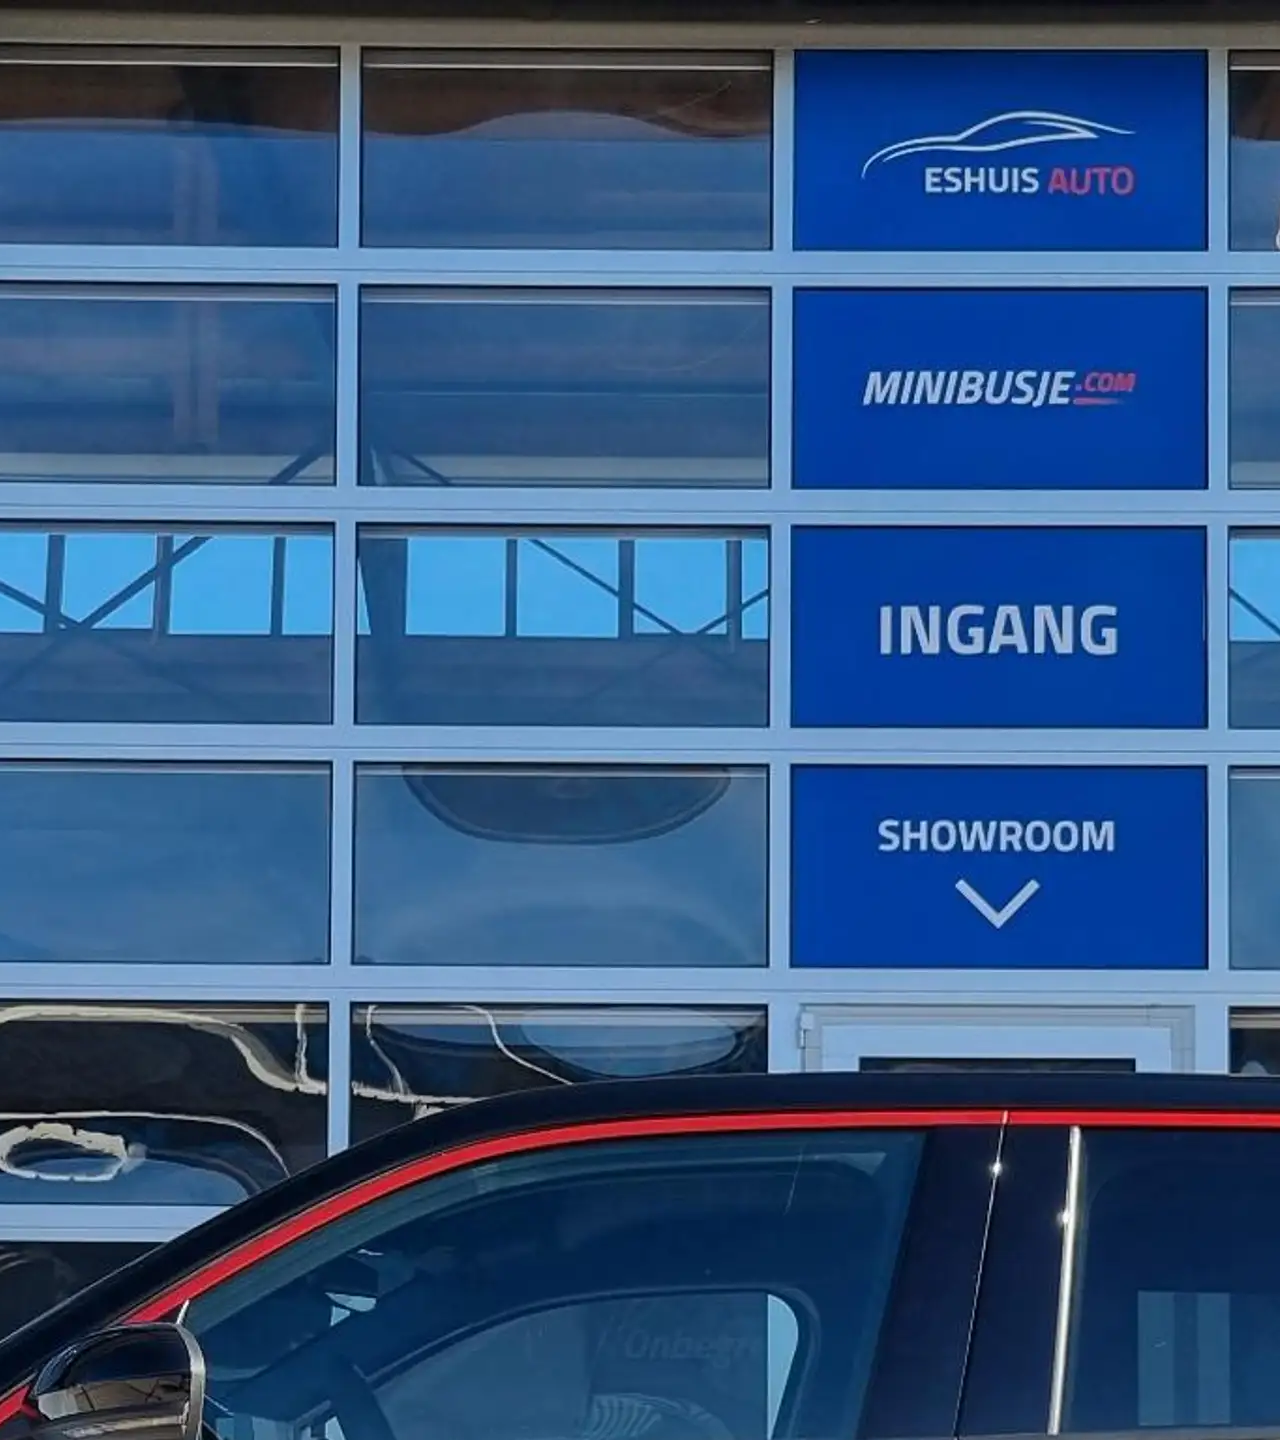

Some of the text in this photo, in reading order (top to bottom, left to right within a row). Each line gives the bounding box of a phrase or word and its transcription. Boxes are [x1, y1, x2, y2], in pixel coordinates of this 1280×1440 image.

[924, 166, 1136, 195] ESHUIS AUTO
[879, 605, 1118, 656] INGANG
[877, 819, 1116, 853] SHOWROOM
